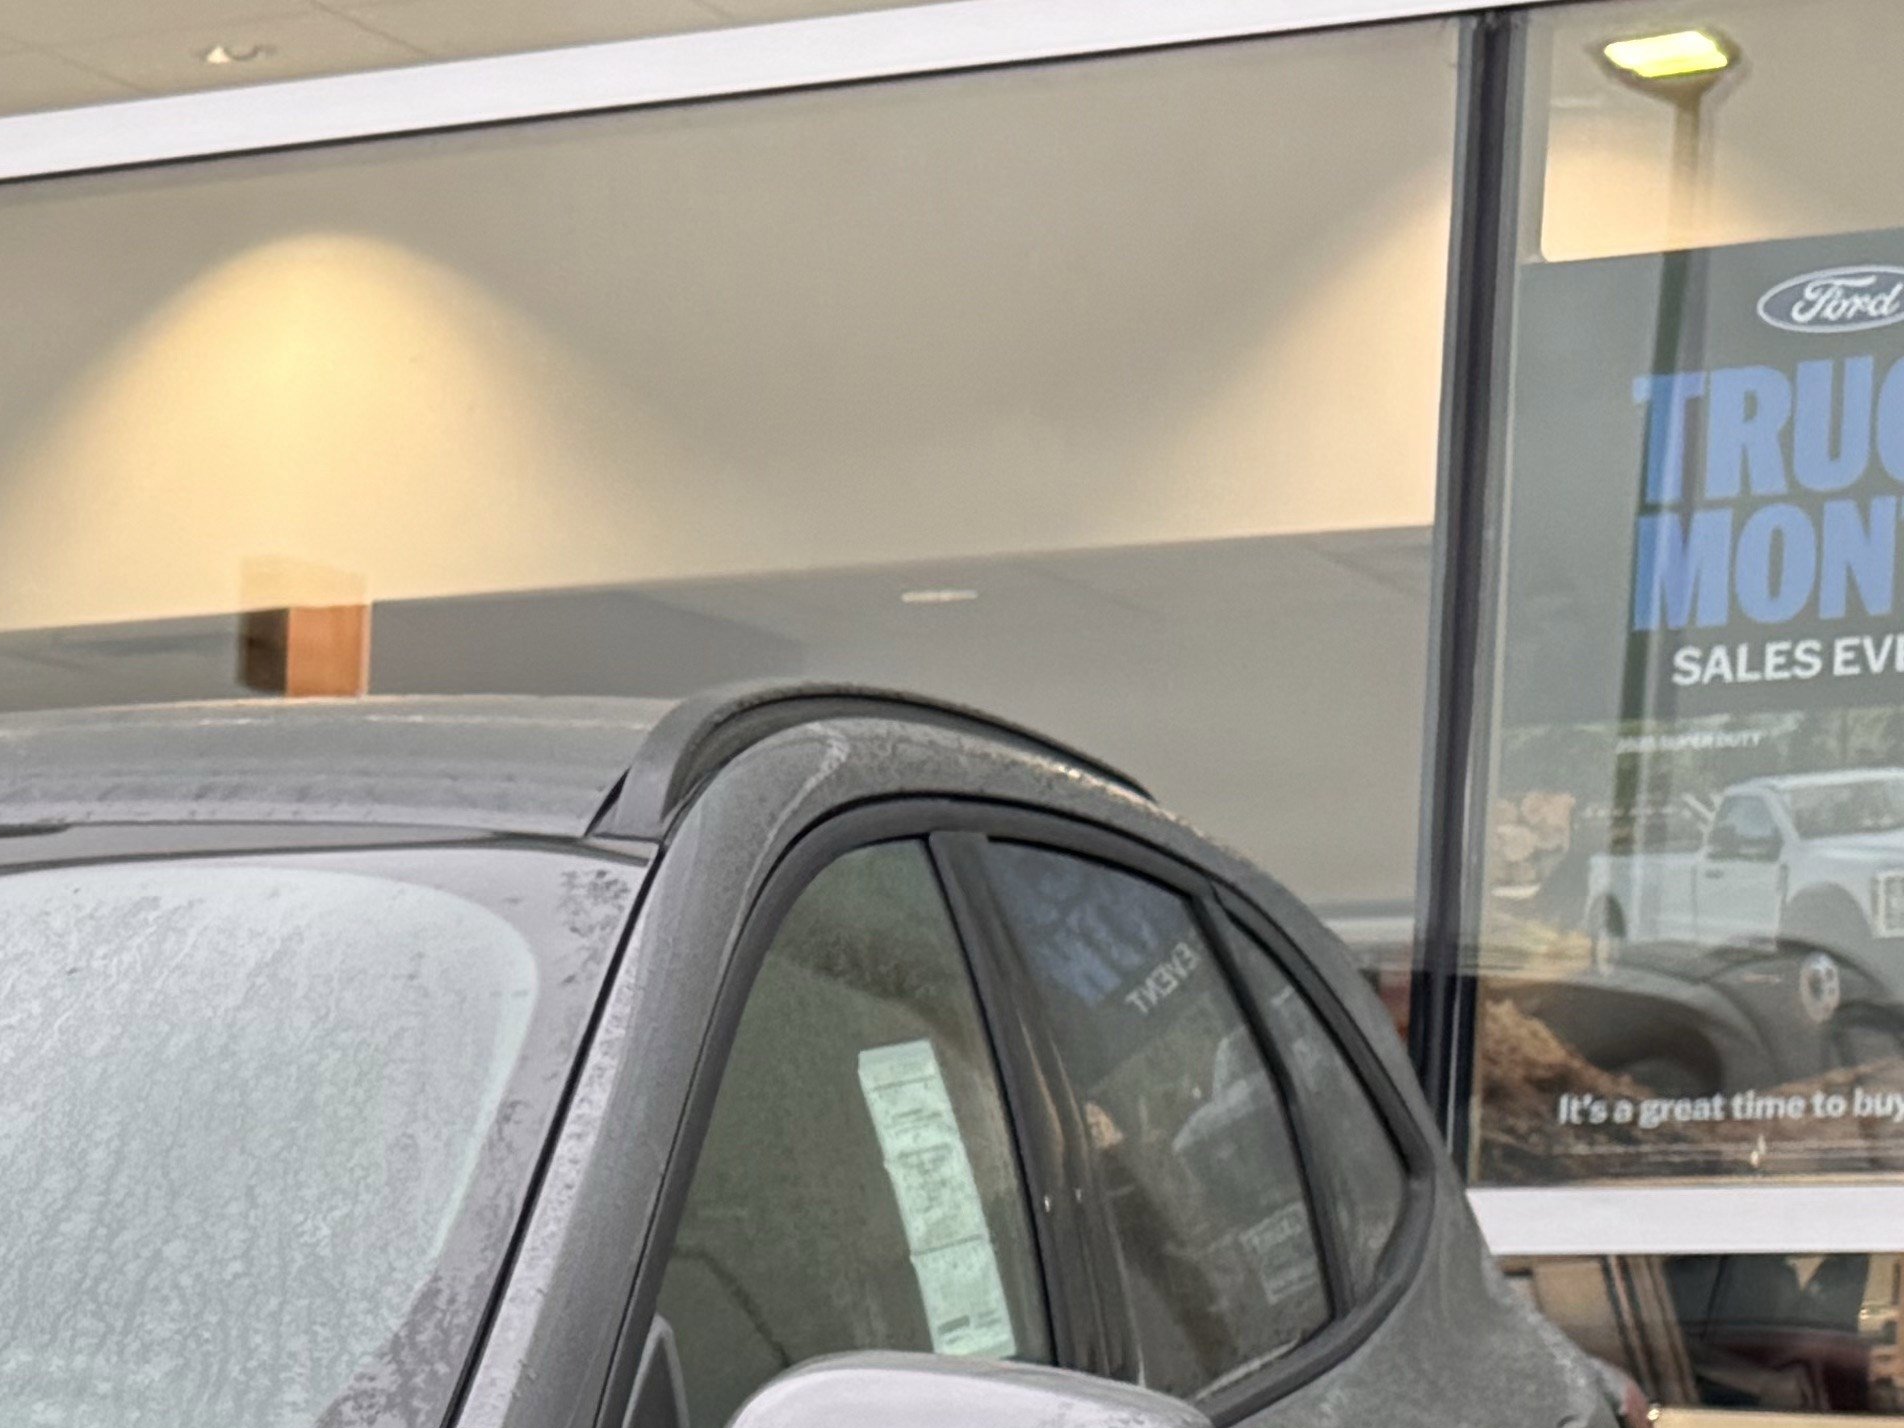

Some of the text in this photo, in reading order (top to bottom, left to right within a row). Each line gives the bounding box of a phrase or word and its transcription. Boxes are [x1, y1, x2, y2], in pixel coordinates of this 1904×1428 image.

[1791, 273, 1902, 324] Ford
[1633, 495, 1904, 632] MON
[1671, 639, 1822, 687] SALES
[1558, 1092, 1608, 1125] It's
[1613, 1101, 1635, 1124] a
[1638, 1092, 1726, 1129] great
[1732, 1088, 1806, 1121] time
[1810, 1090, 1848, 1119] to
